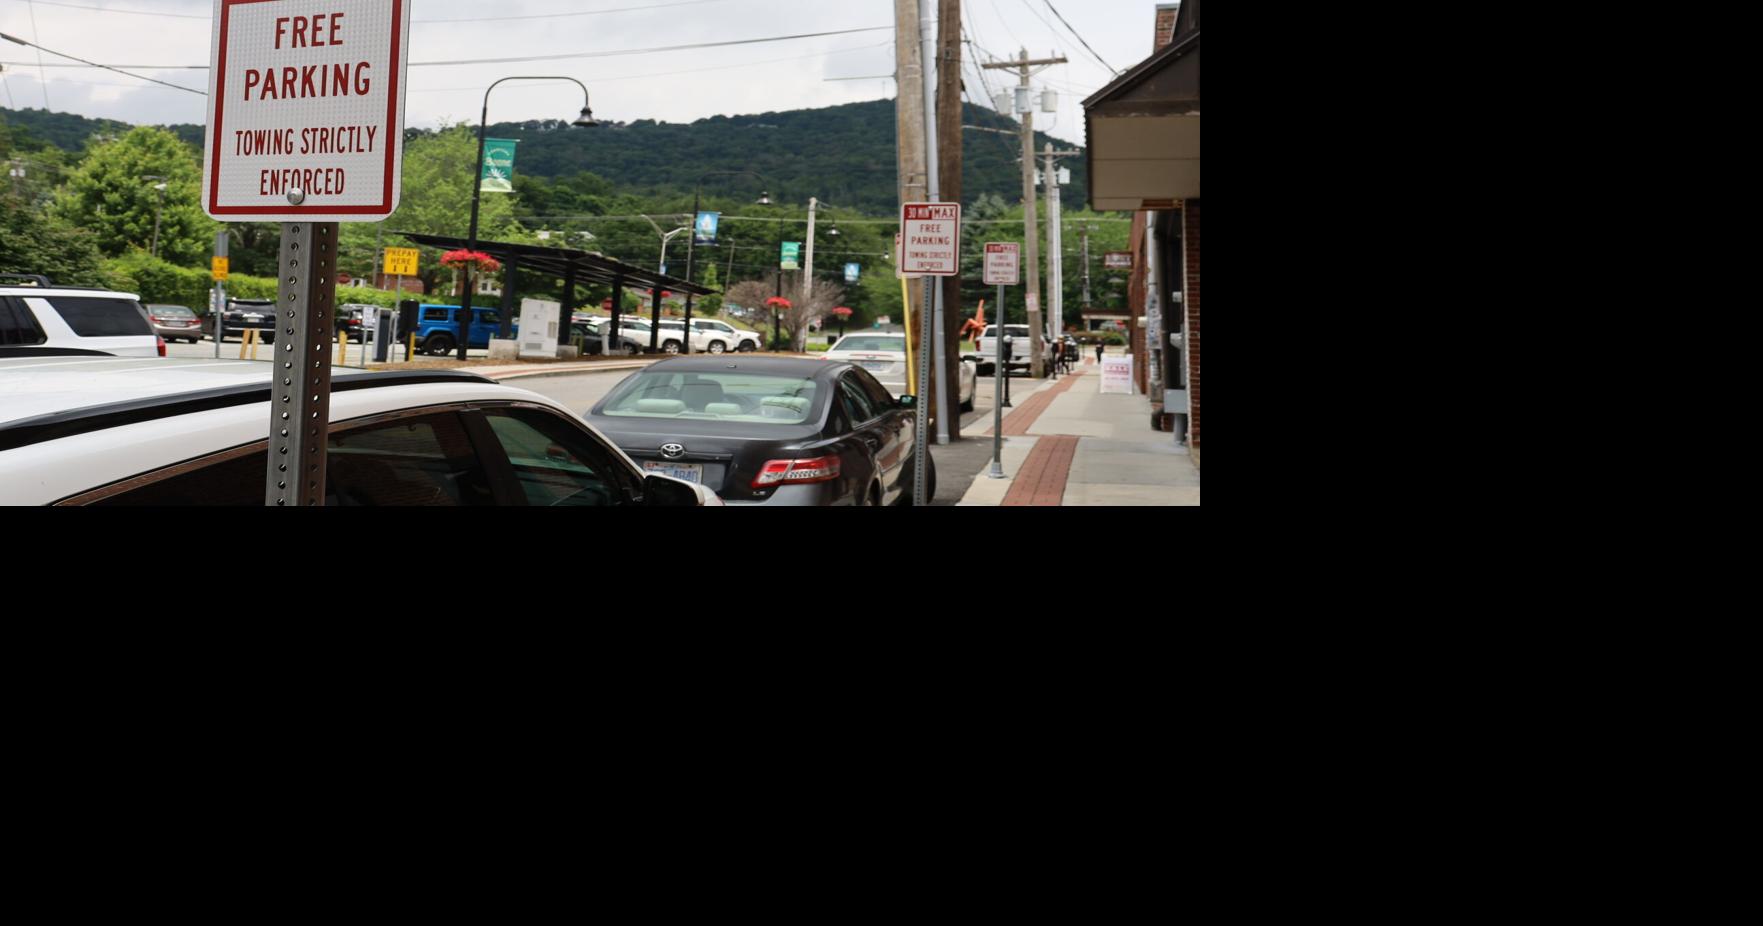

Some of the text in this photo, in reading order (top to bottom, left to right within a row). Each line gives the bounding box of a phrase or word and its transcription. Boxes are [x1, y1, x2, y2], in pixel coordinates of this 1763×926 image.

[274, 12, 345, 49] FREE
[244, 61, 371, 100] PARKING
[235, 125, 377, 156] TOWING STRICTLY
[260, 168, 345, 196] ENFORCED
[908, 207, 916, 218] 30
[934, 207, 955, 218] MAX
[919, 223, 942, 233] FREE
[911, 236, 950, 245] PARKING
[386, 248, 417, 257] PREPAY
[391, 257, 412, 265] HERE
